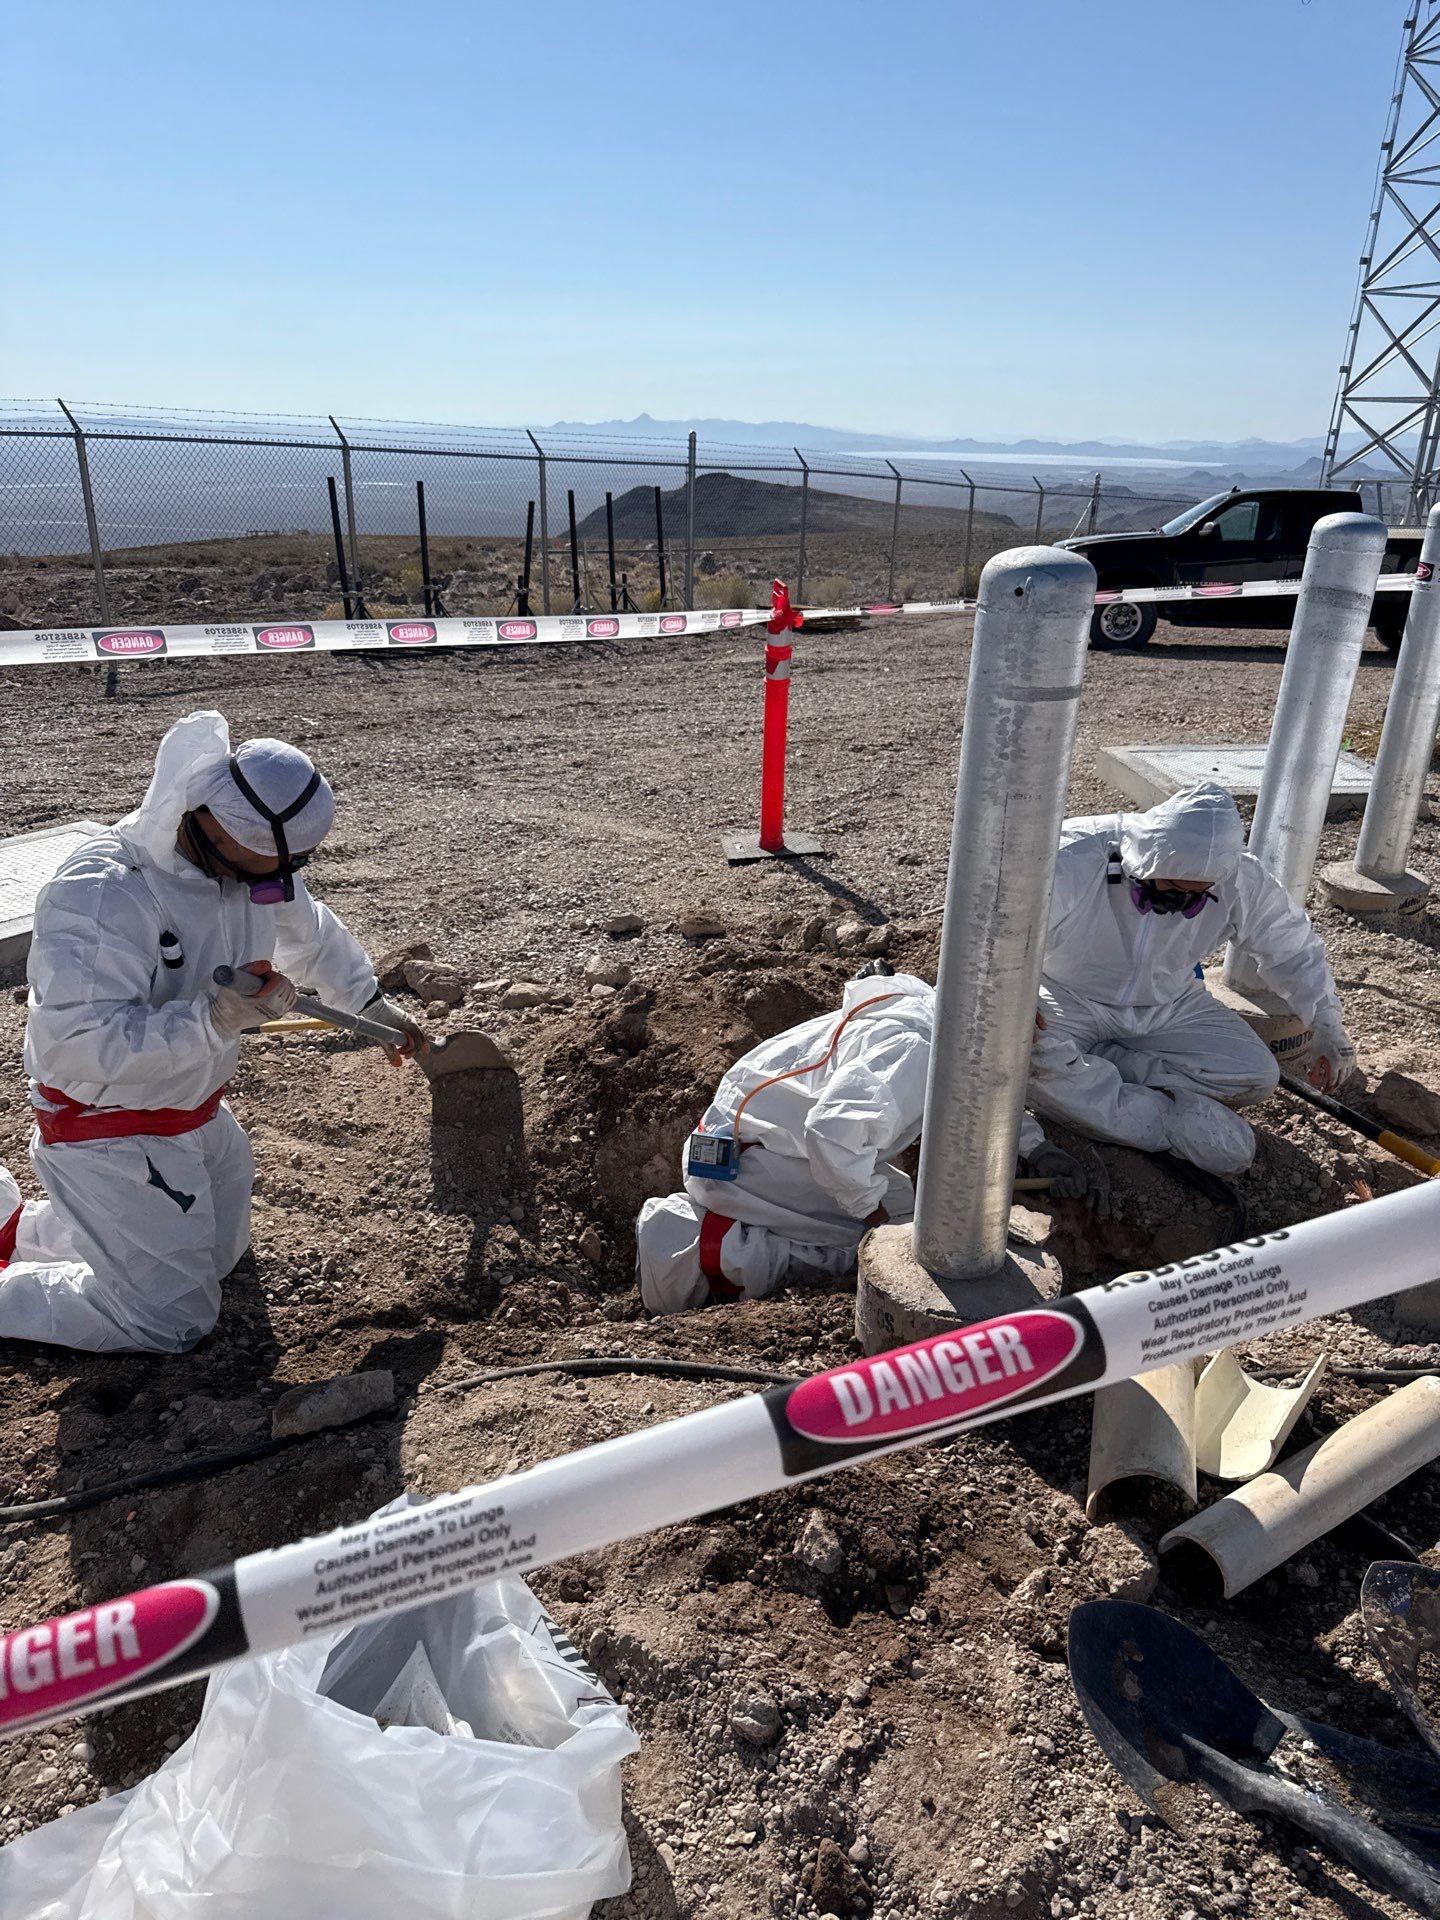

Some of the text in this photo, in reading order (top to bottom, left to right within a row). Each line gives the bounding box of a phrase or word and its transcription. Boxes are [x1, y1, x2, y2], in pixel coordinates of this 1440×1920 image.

[1148, 1264, 1282, 1313] Causes Damage To Lungs
[1159, 1256, 1254, 1292] May Cause Cancer
[1141, 1289, 1307, 1350] Wear Respiratory Protection And
[1154, 1278, 1289, 1330] Authorized Personnel Only
[1141, 1342, 1195, 1363] Protective
[1197, 1328, 1241, 1347] Clothing
[1256, 1314, 1276, 1326] This
[1279, 1307, 1302, 1319] Area
[828, 1324, 1034, 1426] DANGER
[314, 1506, 505, 1575] Causes Damage To Lungs
[315, 1523, 512, 1596] Authorized Personnel Only
[340, 1531, 369, 1547] May
[374, 1515, 421, 1536] Cause
[296, 1534, 537, 1621] Wear Respiratory Protection And
